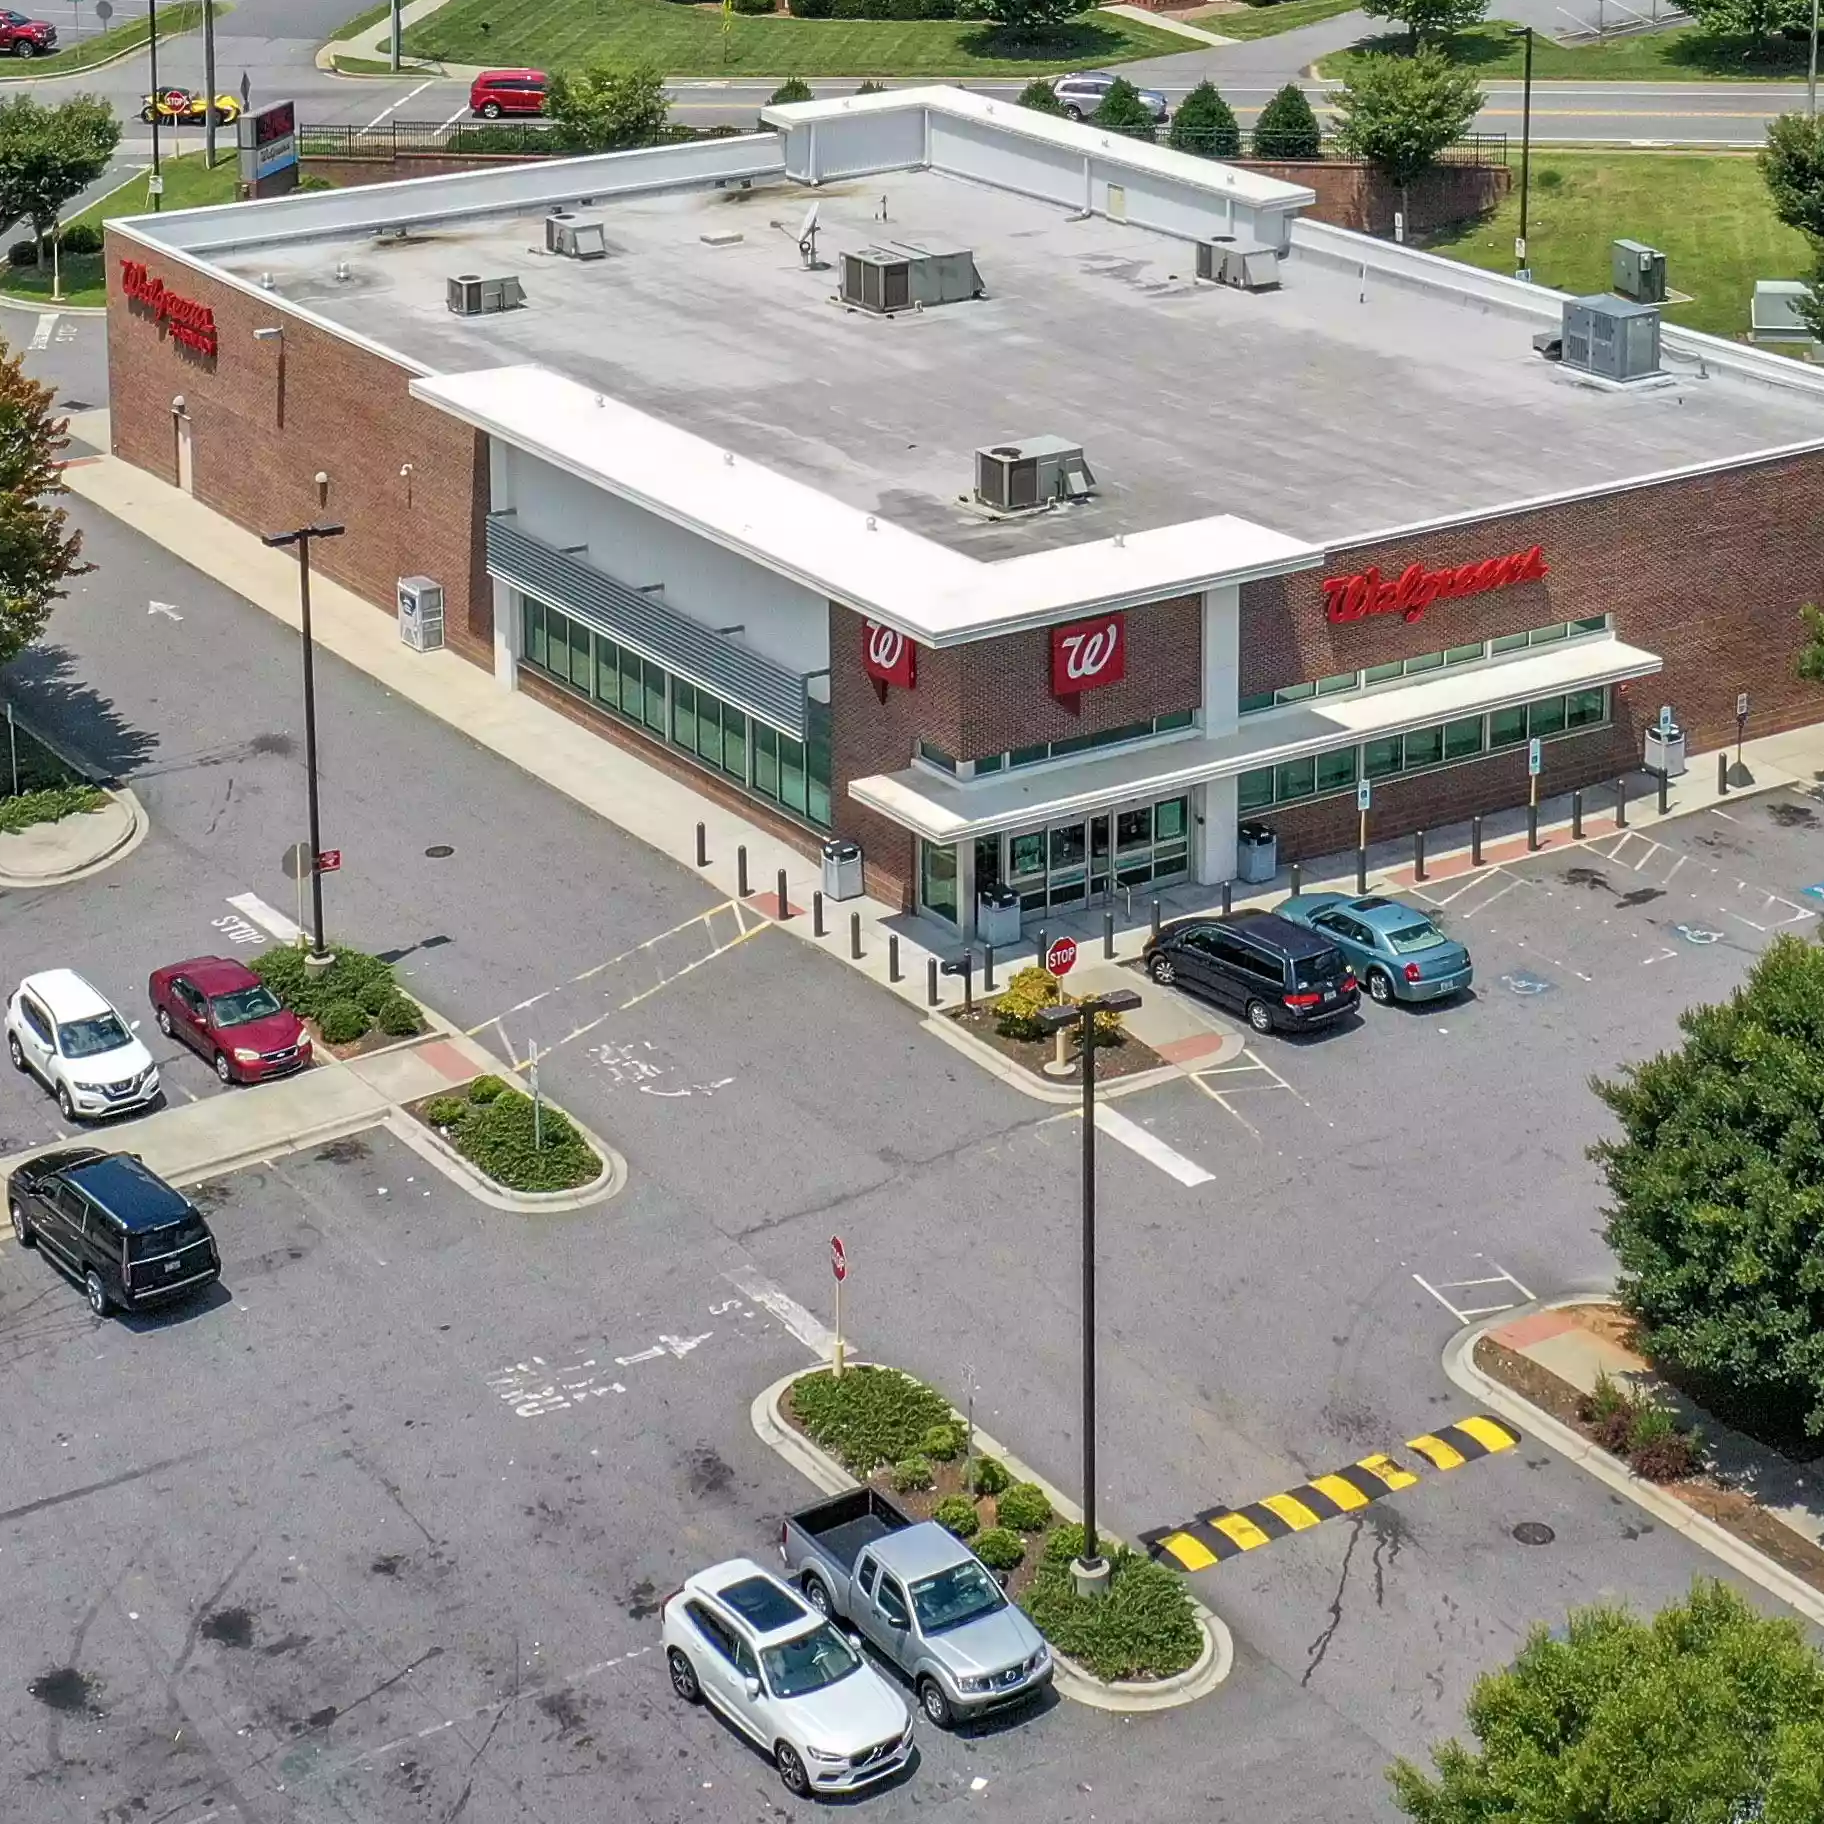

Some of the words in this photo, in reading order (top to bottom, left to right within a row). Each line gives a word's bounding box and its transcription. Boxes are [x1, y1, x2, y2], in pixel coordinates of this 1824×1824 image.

[166, 96, 183, 106] STOP
[120, 259, 216, 332] Walgreens
[1324, 544, 1550, 624] Walgreens
[1062, 624, 1116, 679] W
[210, 915, 268, 944] STOP
[1049, 946, 1075, 968] STOP
